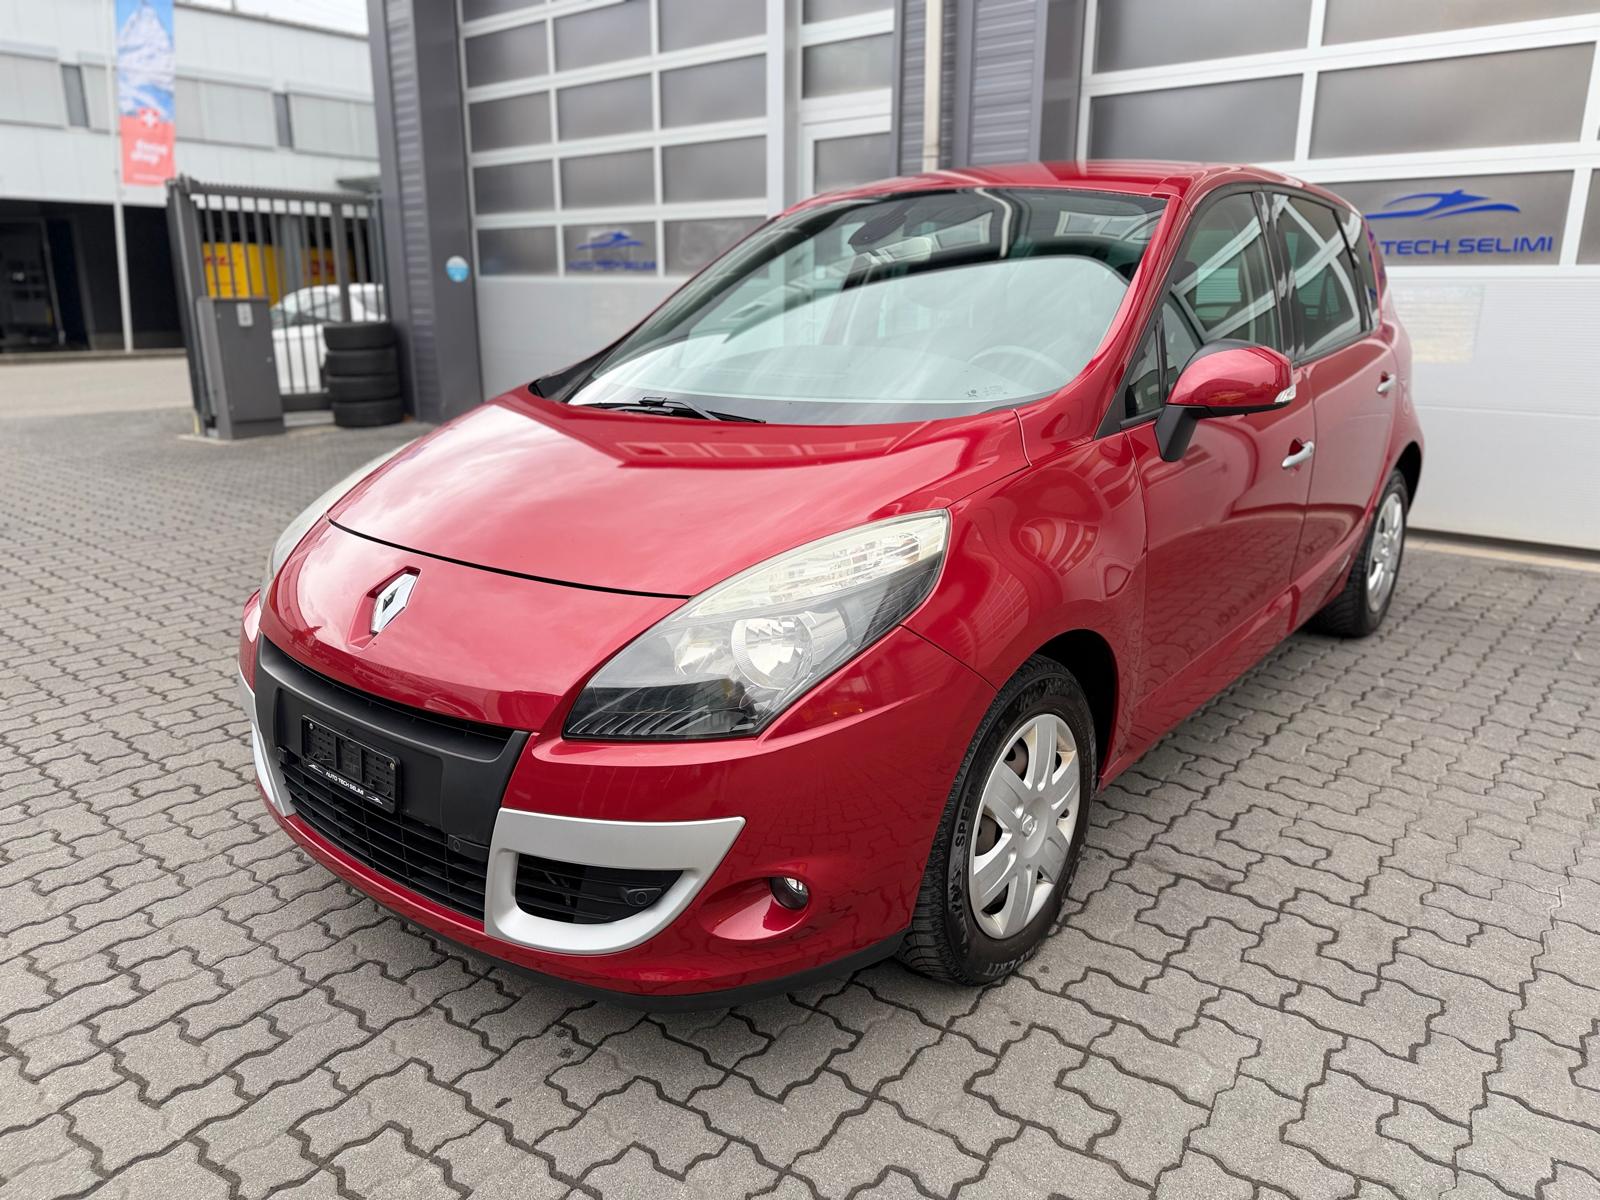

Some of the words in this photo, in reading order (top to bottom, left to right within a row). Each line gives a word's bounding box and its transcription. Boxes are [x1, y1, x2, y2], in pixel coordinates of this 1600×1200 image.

[1380, 239, 1449, 255] TECH
[1457, 236, 1553, 253] SELIMI
[325, 771, 338, 781] AUTO
[338, 777, 350, 788] TECH
